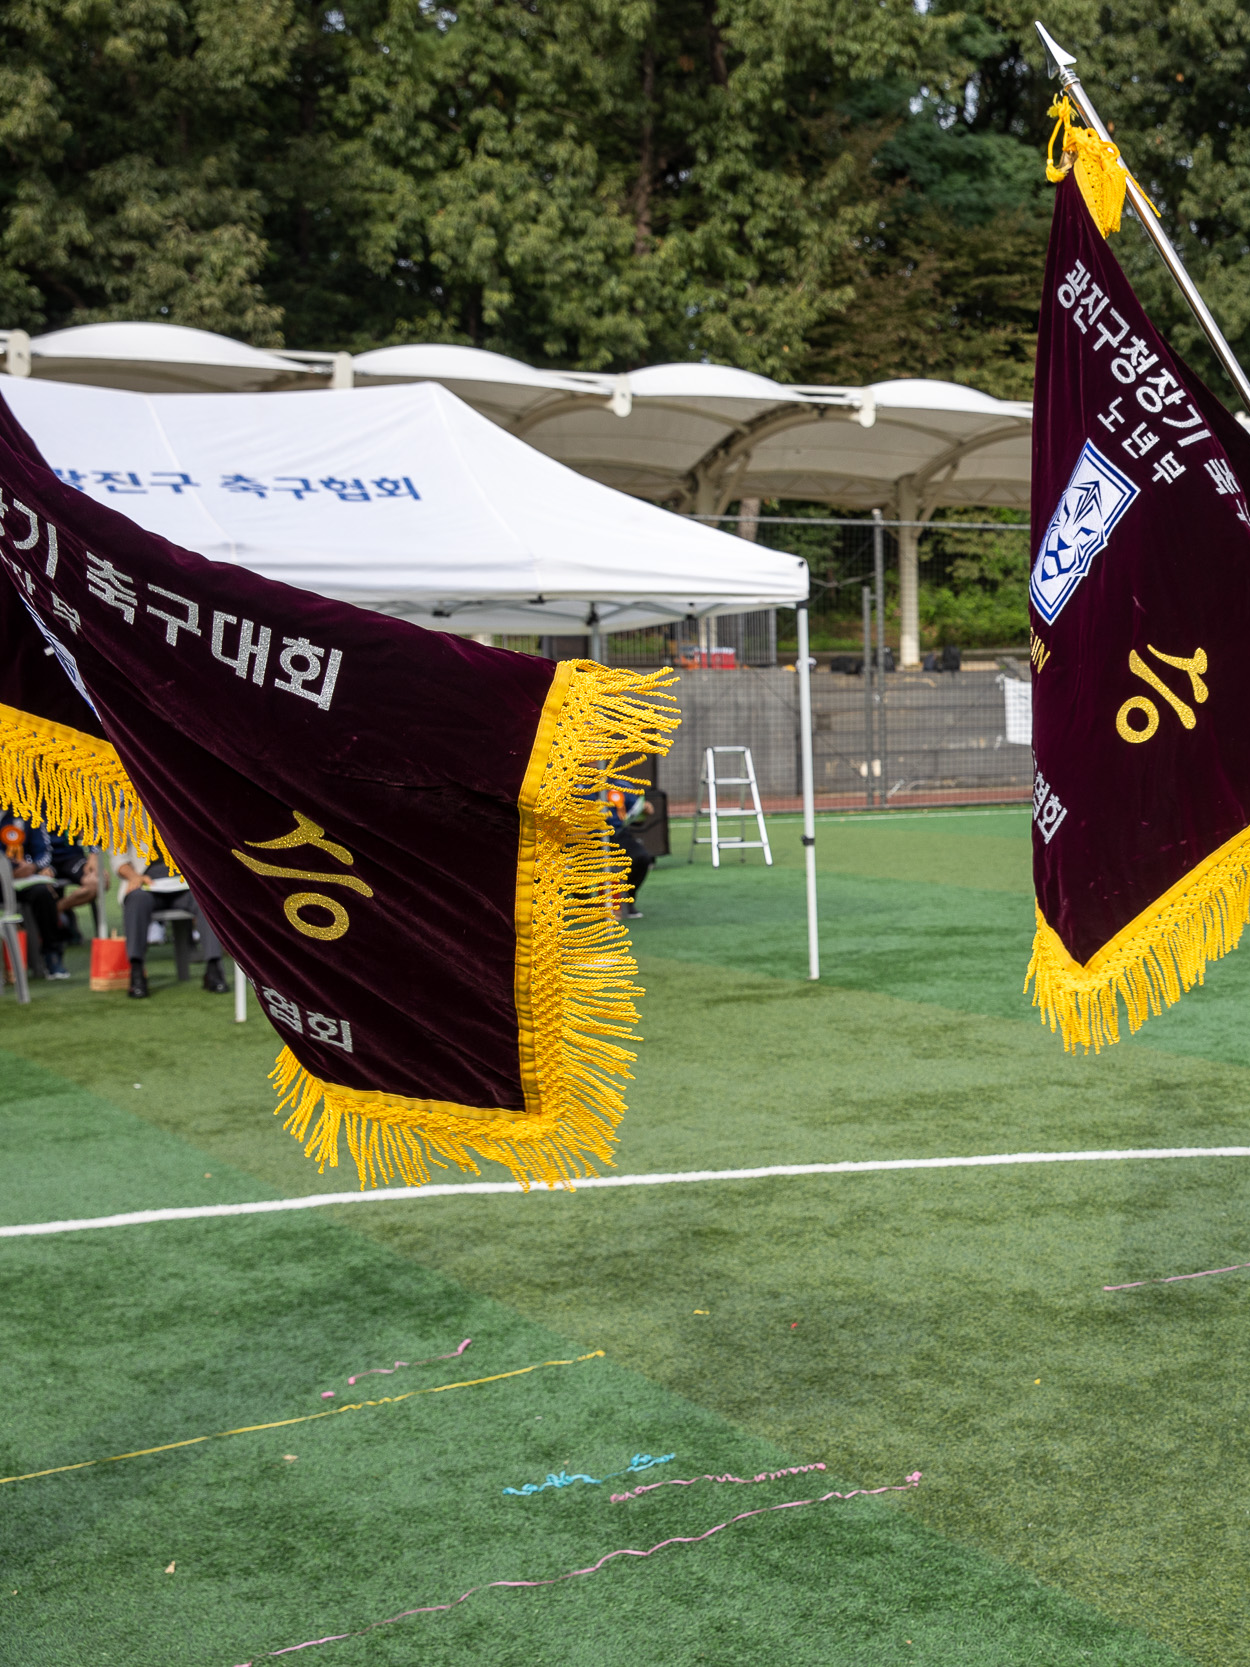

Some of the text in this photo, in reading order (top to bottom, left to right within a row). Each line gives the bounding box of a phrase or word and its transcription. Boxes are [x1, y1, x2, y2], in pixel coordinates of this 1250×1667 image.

[1057, 259, 1212, 447] 광진구청장기
[220, 473, 422, 502] 축구협회
[1097, 397, 1187, 484] 노년부
[86, 551, 343, 711] 축구대회
[1115, 644, 1208, 743] 승
[1033, 751, 1068, 844] 협회
[231, 810, 374, 941] 승
[248, 977, 353, 1053] 협회
